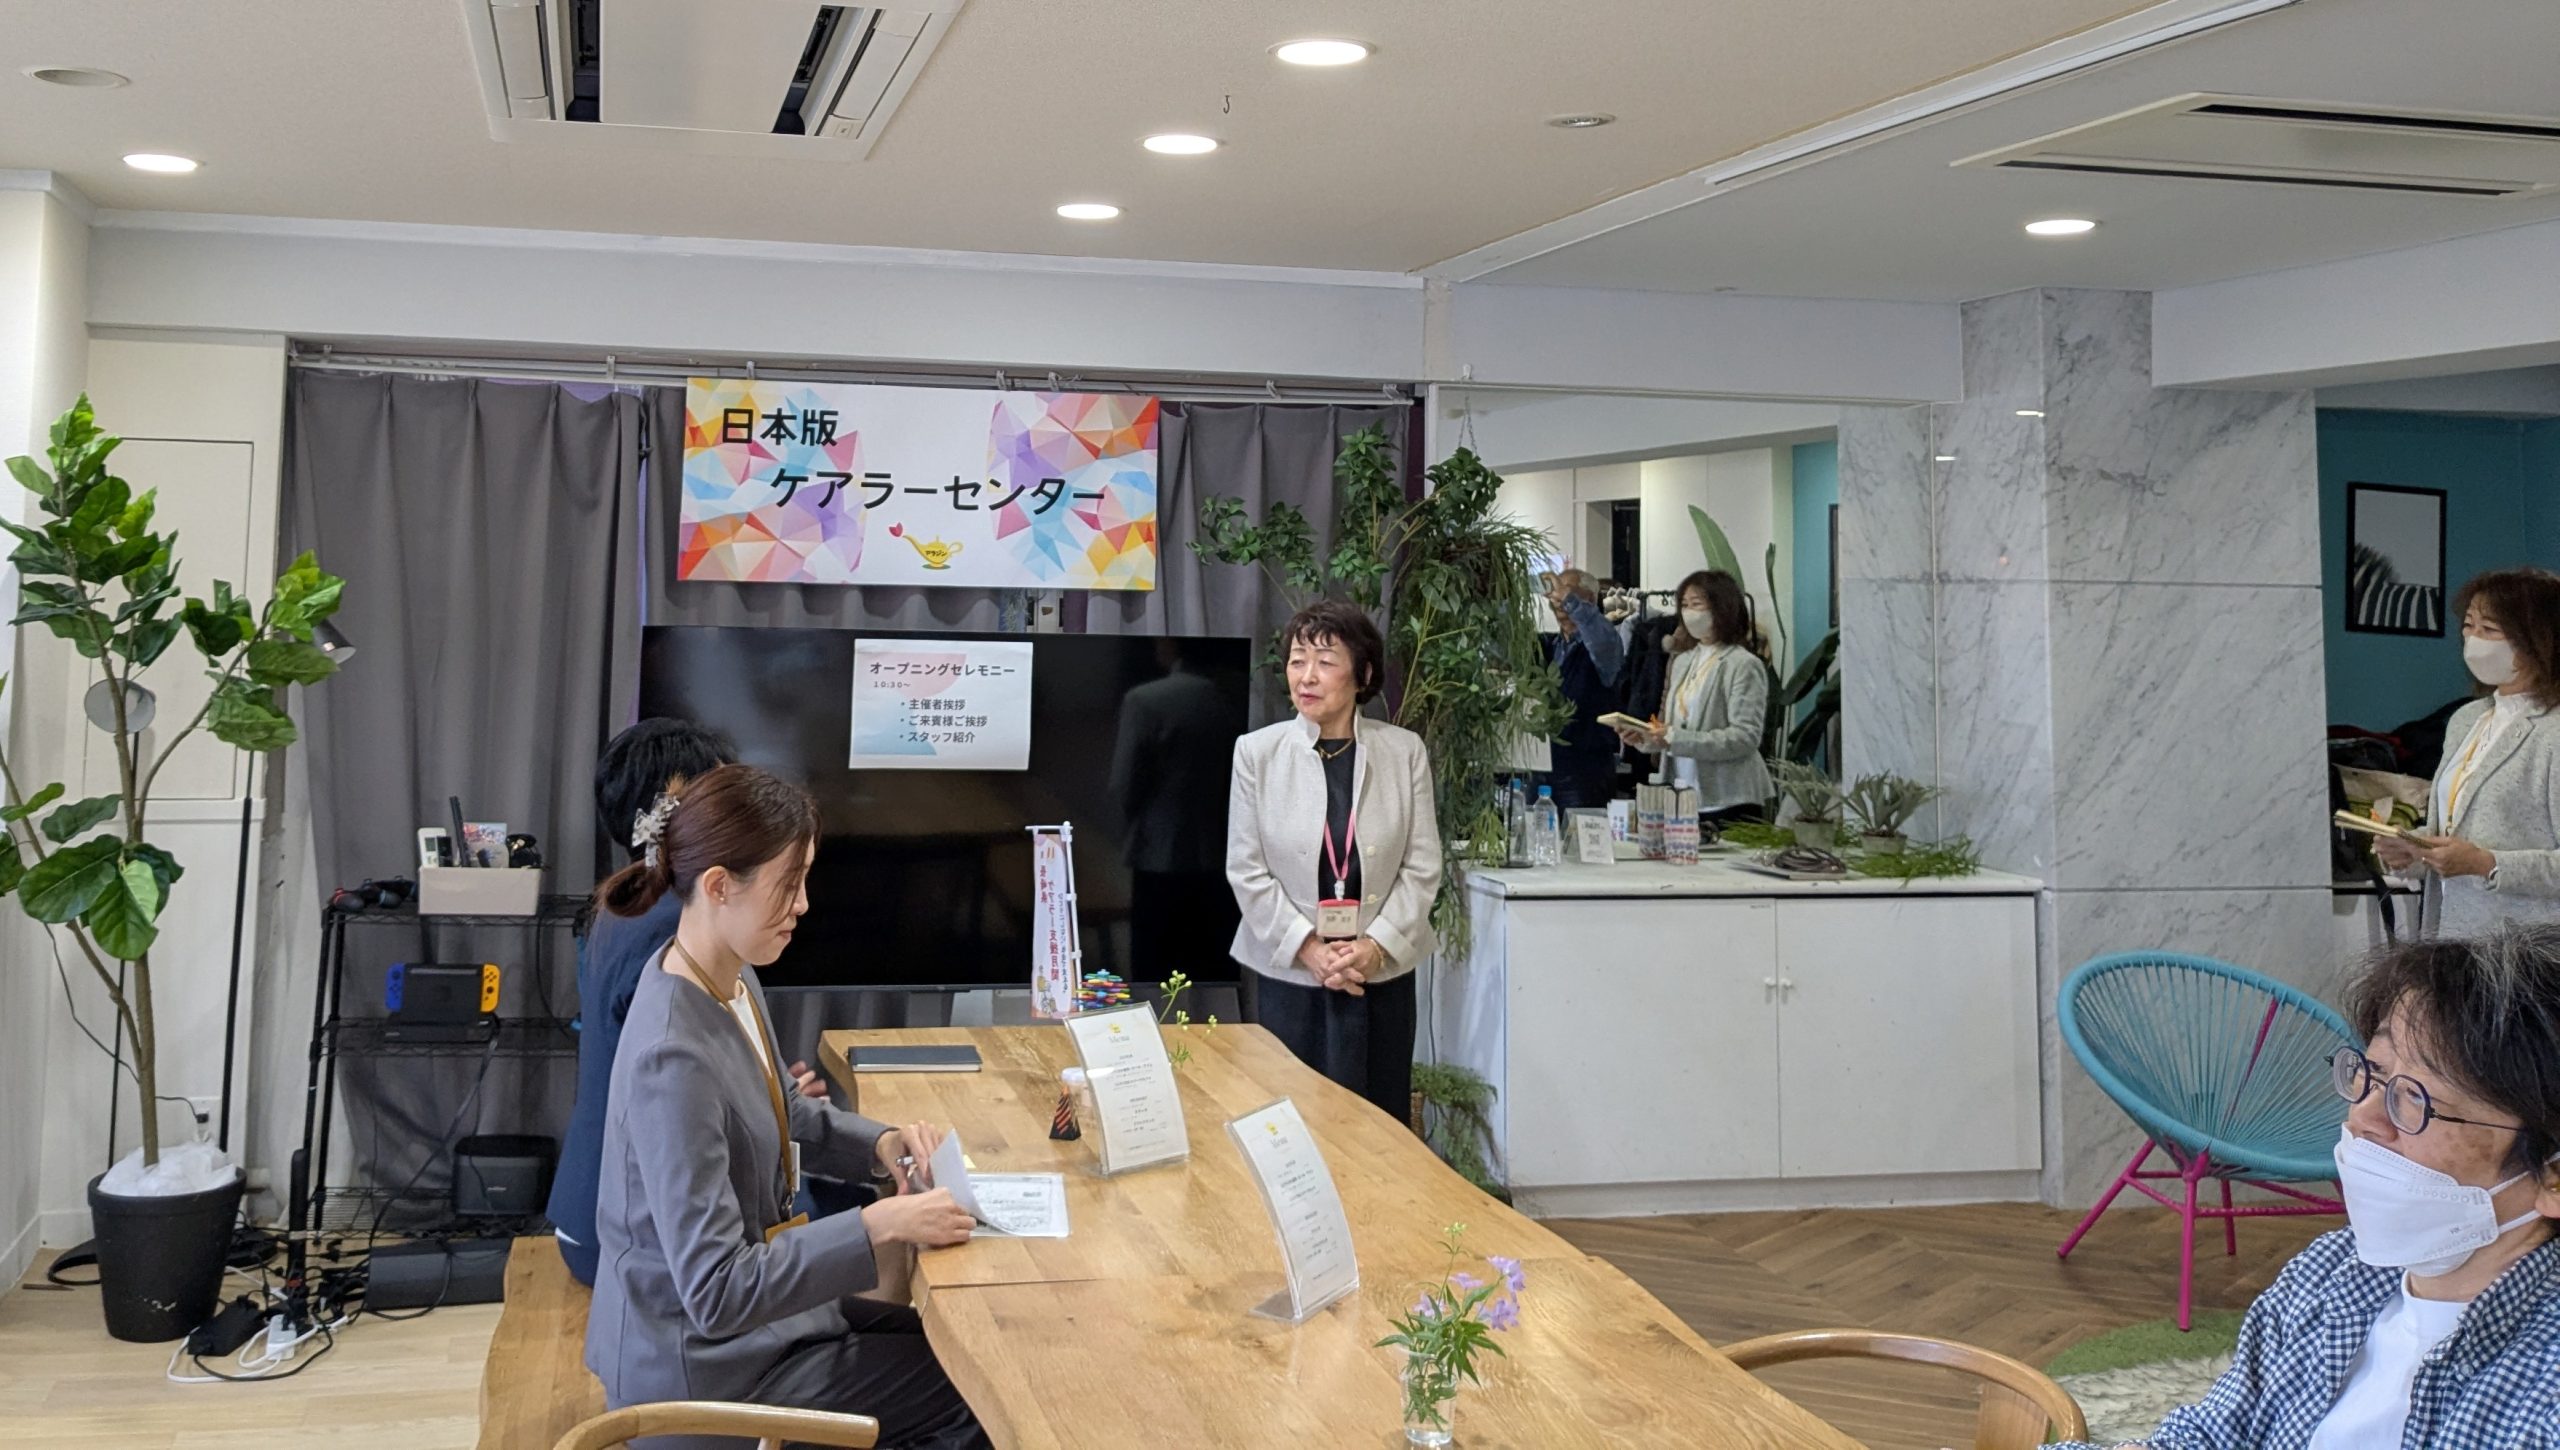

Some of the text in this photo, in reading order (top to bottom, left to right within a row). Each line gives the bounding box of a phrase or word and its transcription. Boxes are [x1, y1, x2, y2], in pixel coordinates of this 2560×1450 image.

[721, 407, 839, 447] 日本版
[770, 467, 1105, 515] ケアラーセンター
[925, 549, 948, 558] アラジン
[869, 661, 1016, 677] オープニングセレモニー
